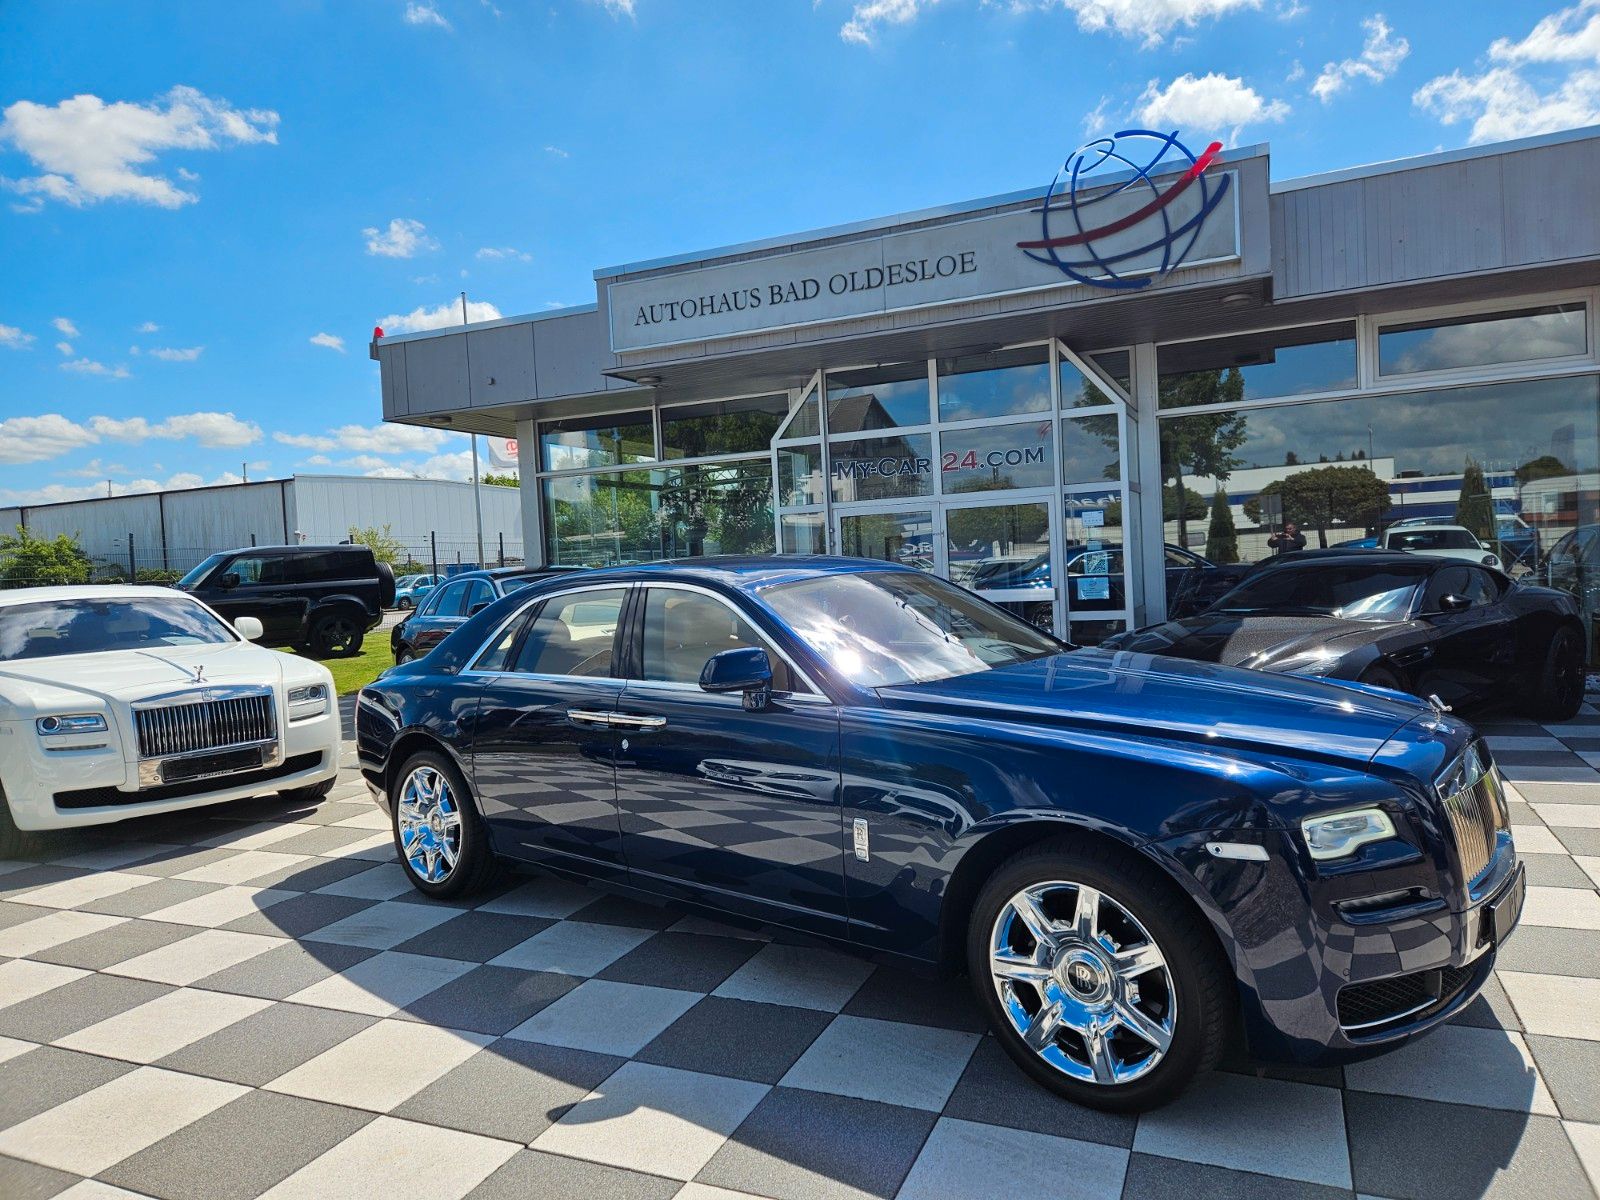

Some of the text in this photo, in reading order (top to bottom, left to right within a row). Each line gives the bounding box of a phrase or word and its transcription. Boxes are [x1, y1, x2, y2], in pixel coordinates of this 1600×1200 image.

[634, 251, 978, 326] AUTOHAUS BAD OLDESLOE
